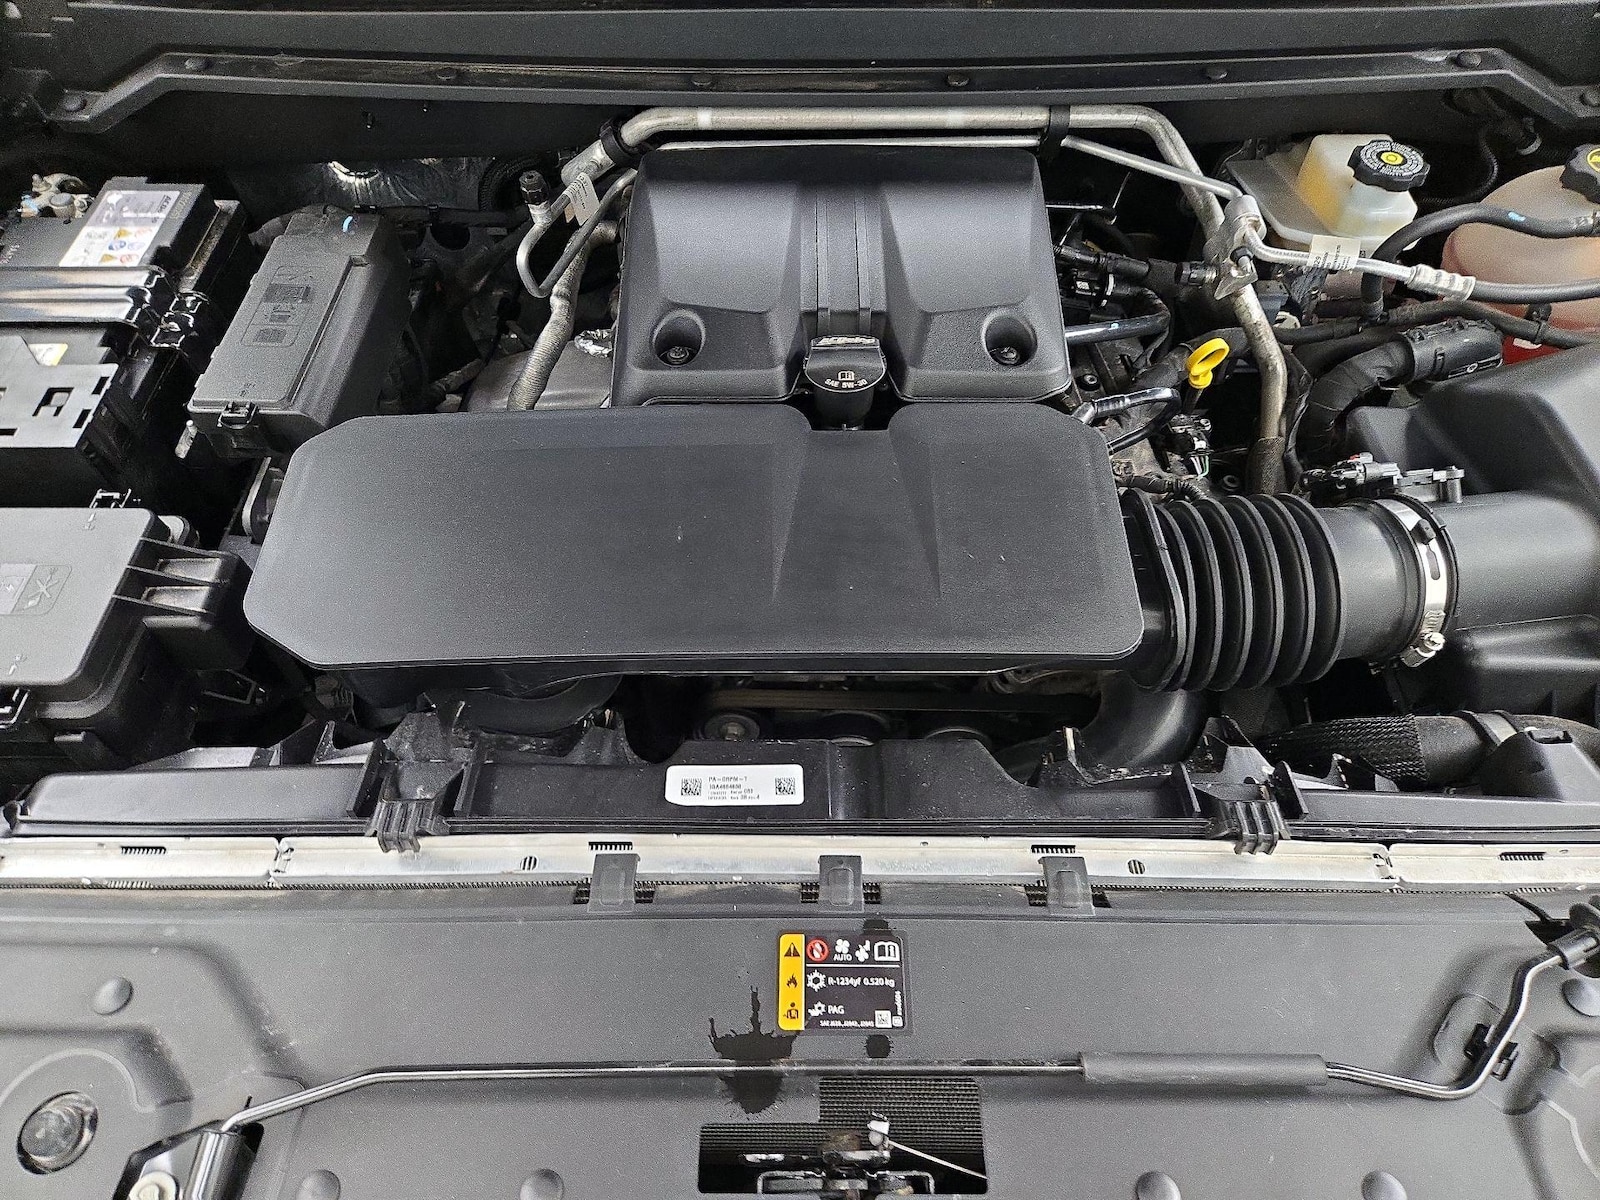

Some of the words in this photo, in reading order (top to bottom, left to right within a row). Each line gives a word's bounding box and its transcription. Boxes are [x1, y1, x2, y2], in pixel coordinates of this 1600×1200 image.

[825, 379, 840, 387] SAE
[841, 379, 868, 388] 5W-30
[833, 953, 852, 961] AUTO
[828, 977, 861, 987] R-1234yf
[863, 977, 884, 986] 0.520
[885, 977, 895, 988] kg
[828, 1005, 845, 1014] PAG
